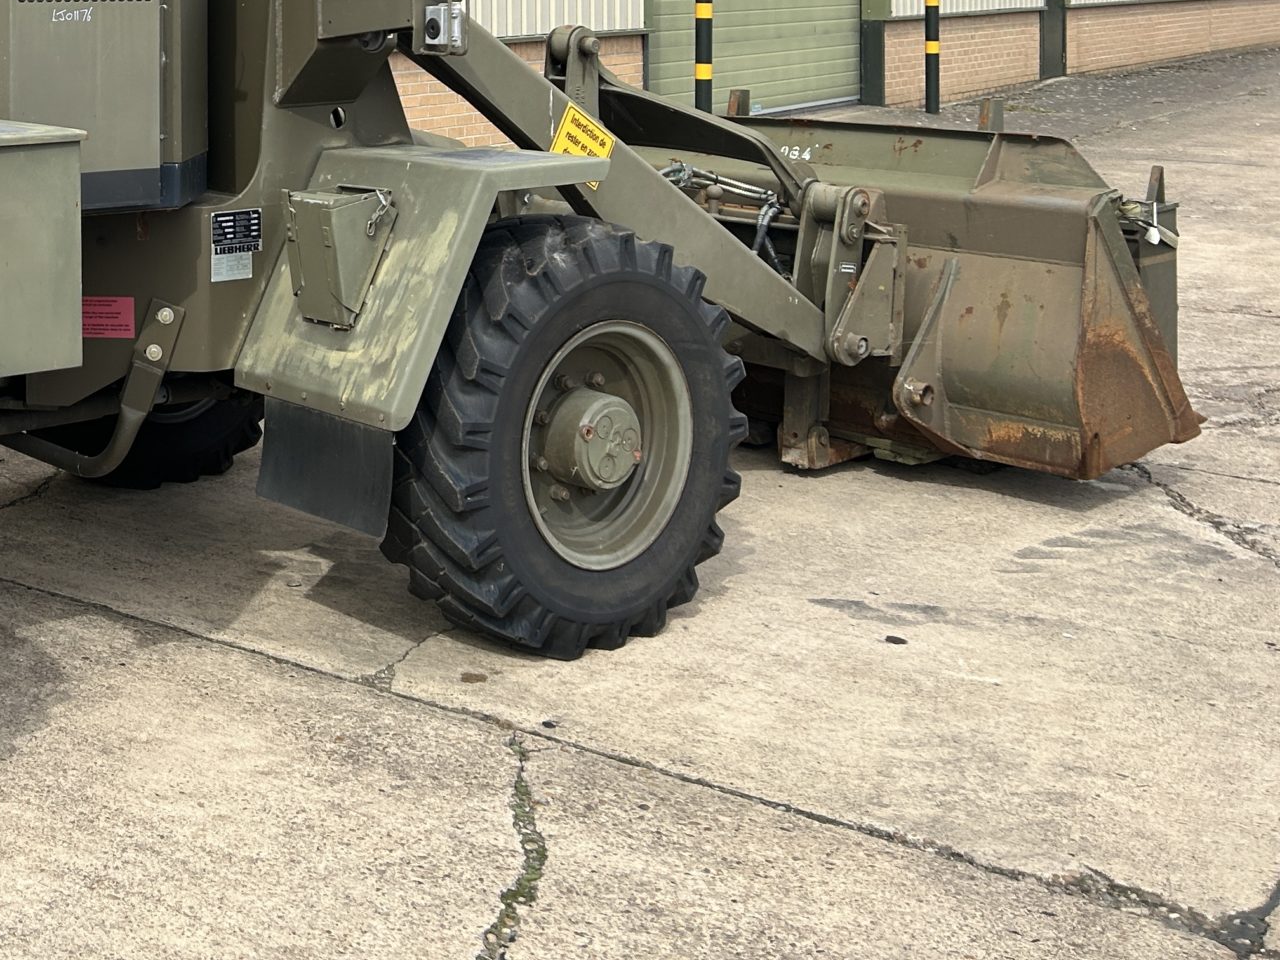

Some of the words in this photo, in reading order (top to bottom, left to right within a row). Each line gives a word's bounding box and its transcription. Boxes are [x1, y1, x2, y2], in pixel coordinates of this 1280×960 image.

[571, 113, 600, 143] Interdiction
[598, 138, 607, 149] de
[580, 141, 588, 153] en
[214, 243, 260, 256] LIEBHERR
